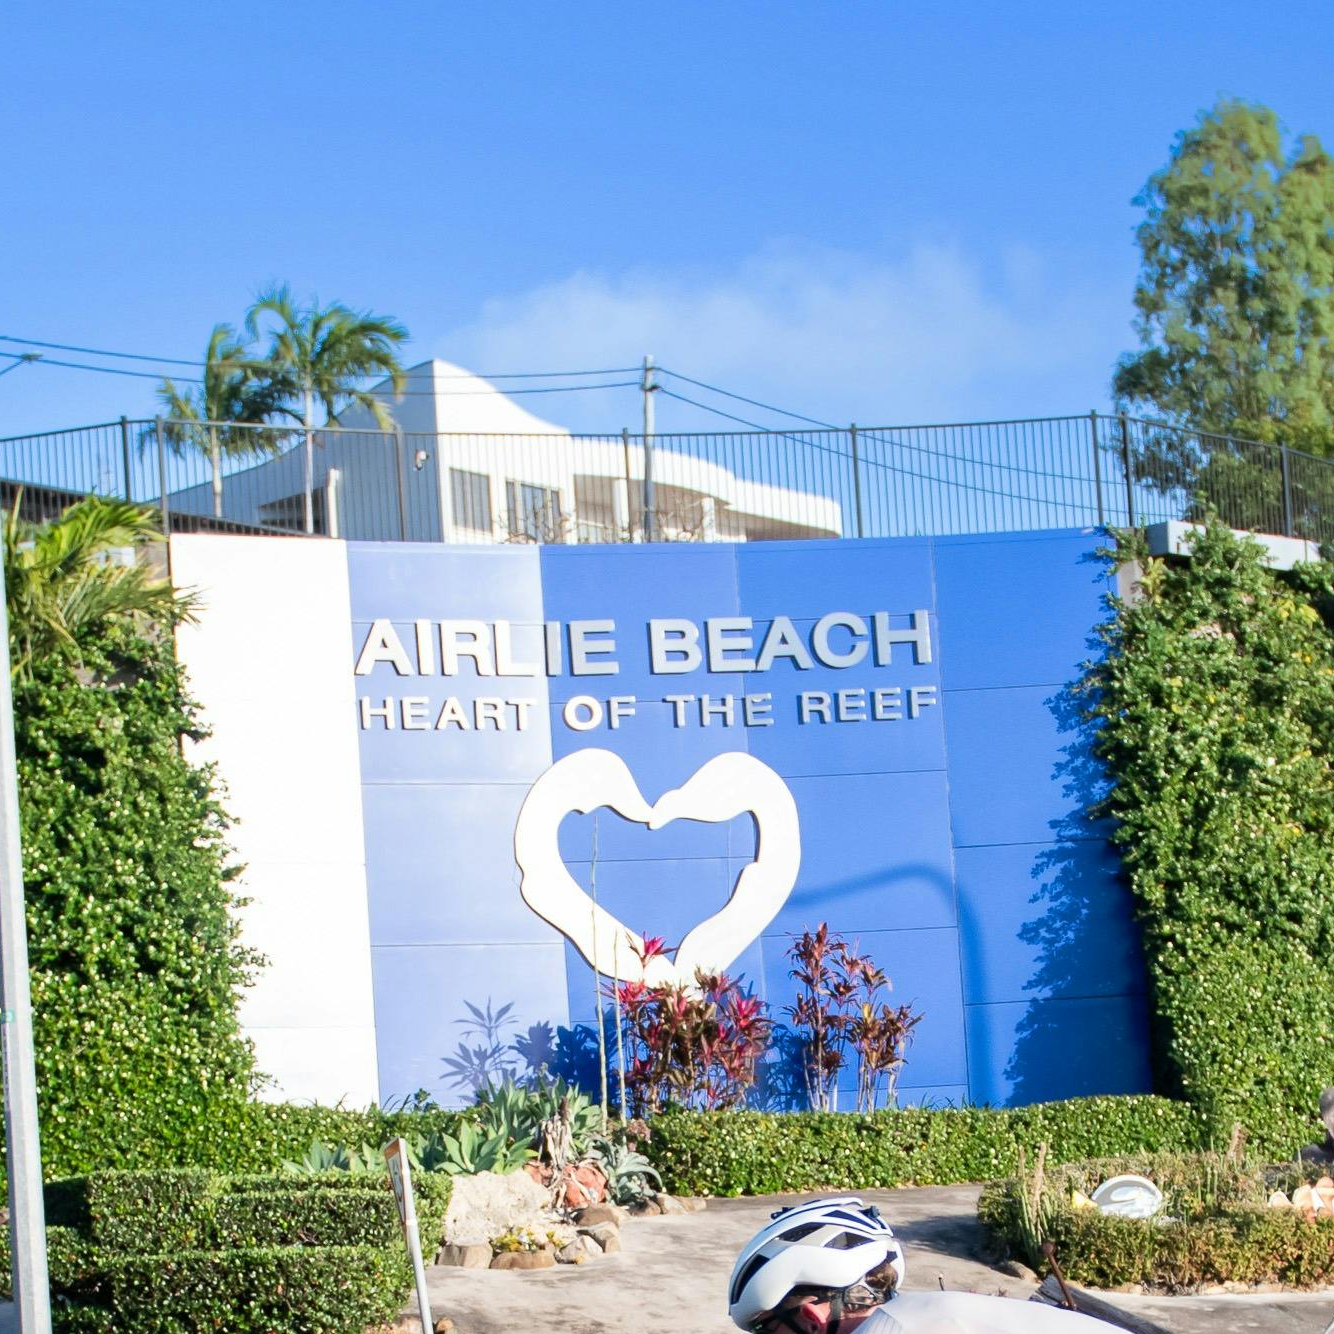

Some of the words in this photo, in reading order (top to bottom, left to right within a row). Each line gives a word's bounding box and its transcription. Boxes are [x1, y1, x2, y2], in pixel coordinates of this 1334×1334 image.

[354, 619, 619, 677] AIRLIE
[647, 610, 933, 675] BEACH
[360, 695, 539, 731] HEART
[564, 693, 638, 732] OF
[664, 691, 775, 729] THE
[799, 685, 937, 725] REEF
